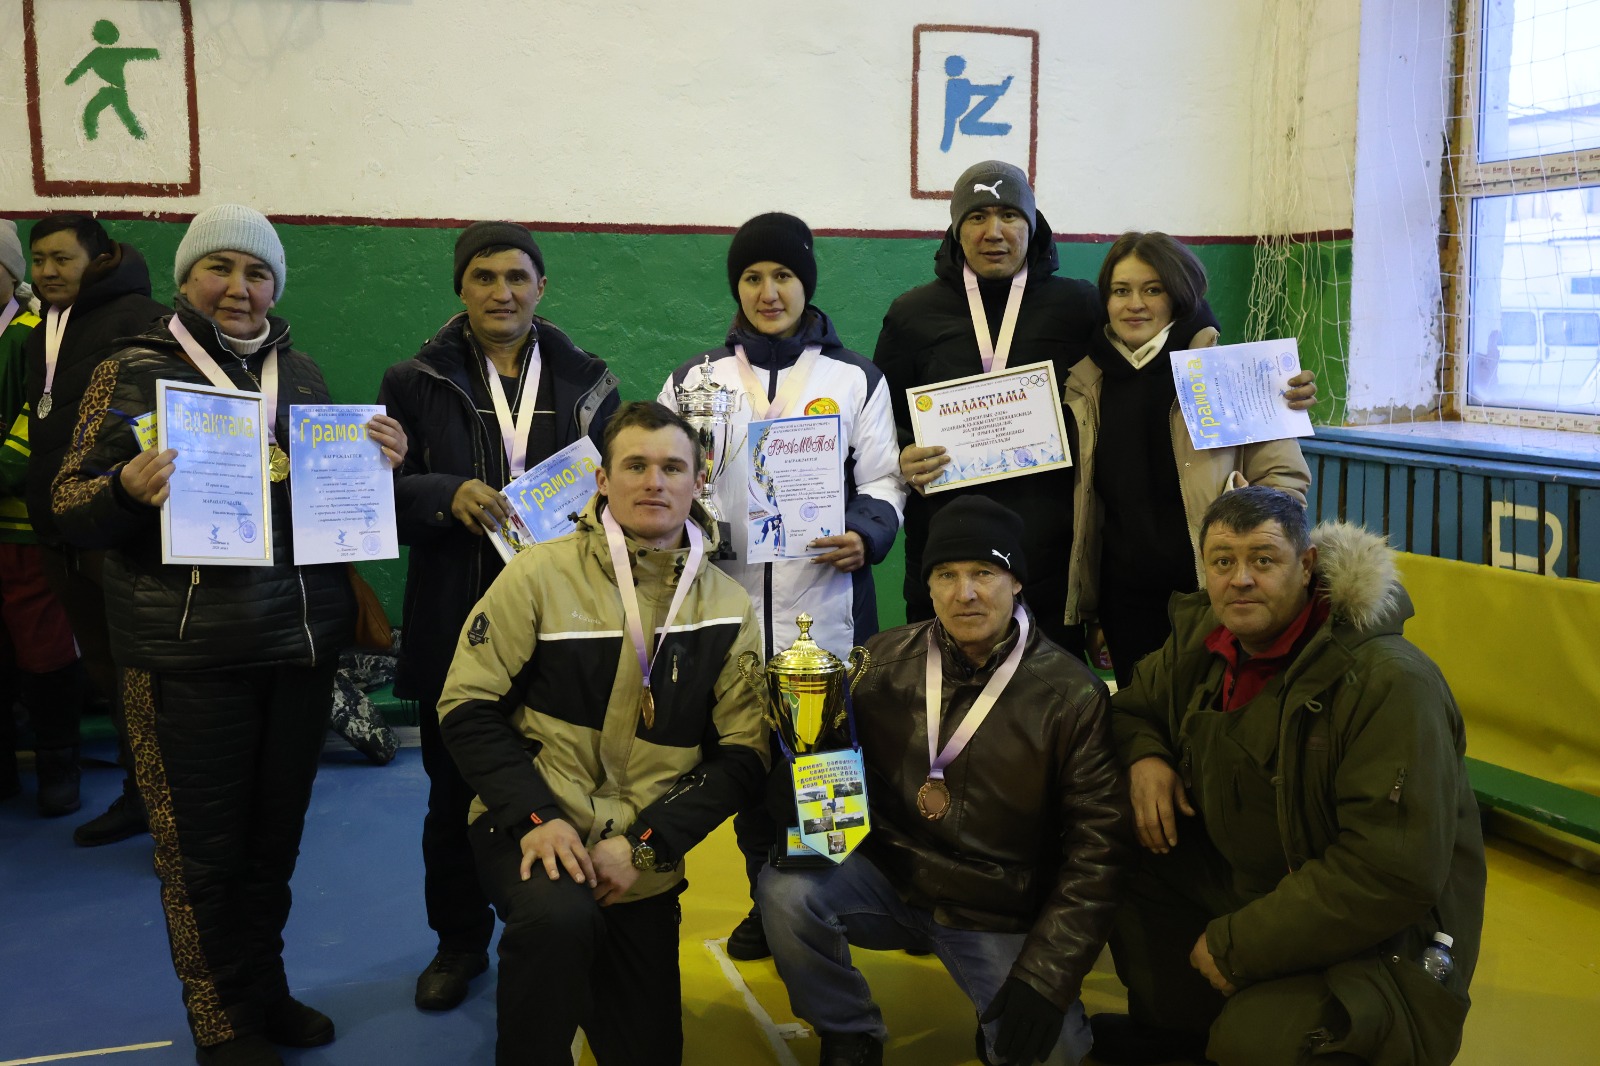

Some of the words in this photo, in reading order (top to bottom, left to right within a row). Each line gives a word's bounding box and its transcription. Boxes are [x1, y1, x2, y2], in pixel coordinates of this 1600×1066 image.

[939, 388, 1028, 417] МАДАҚТАМА
[1188, 357, 1221, 439] Грамота
[300, 418, 369, 449] Грамот
[768, 434, 837, 456] ГРАМОТА
[519, 457, 597, 511] Грамота
